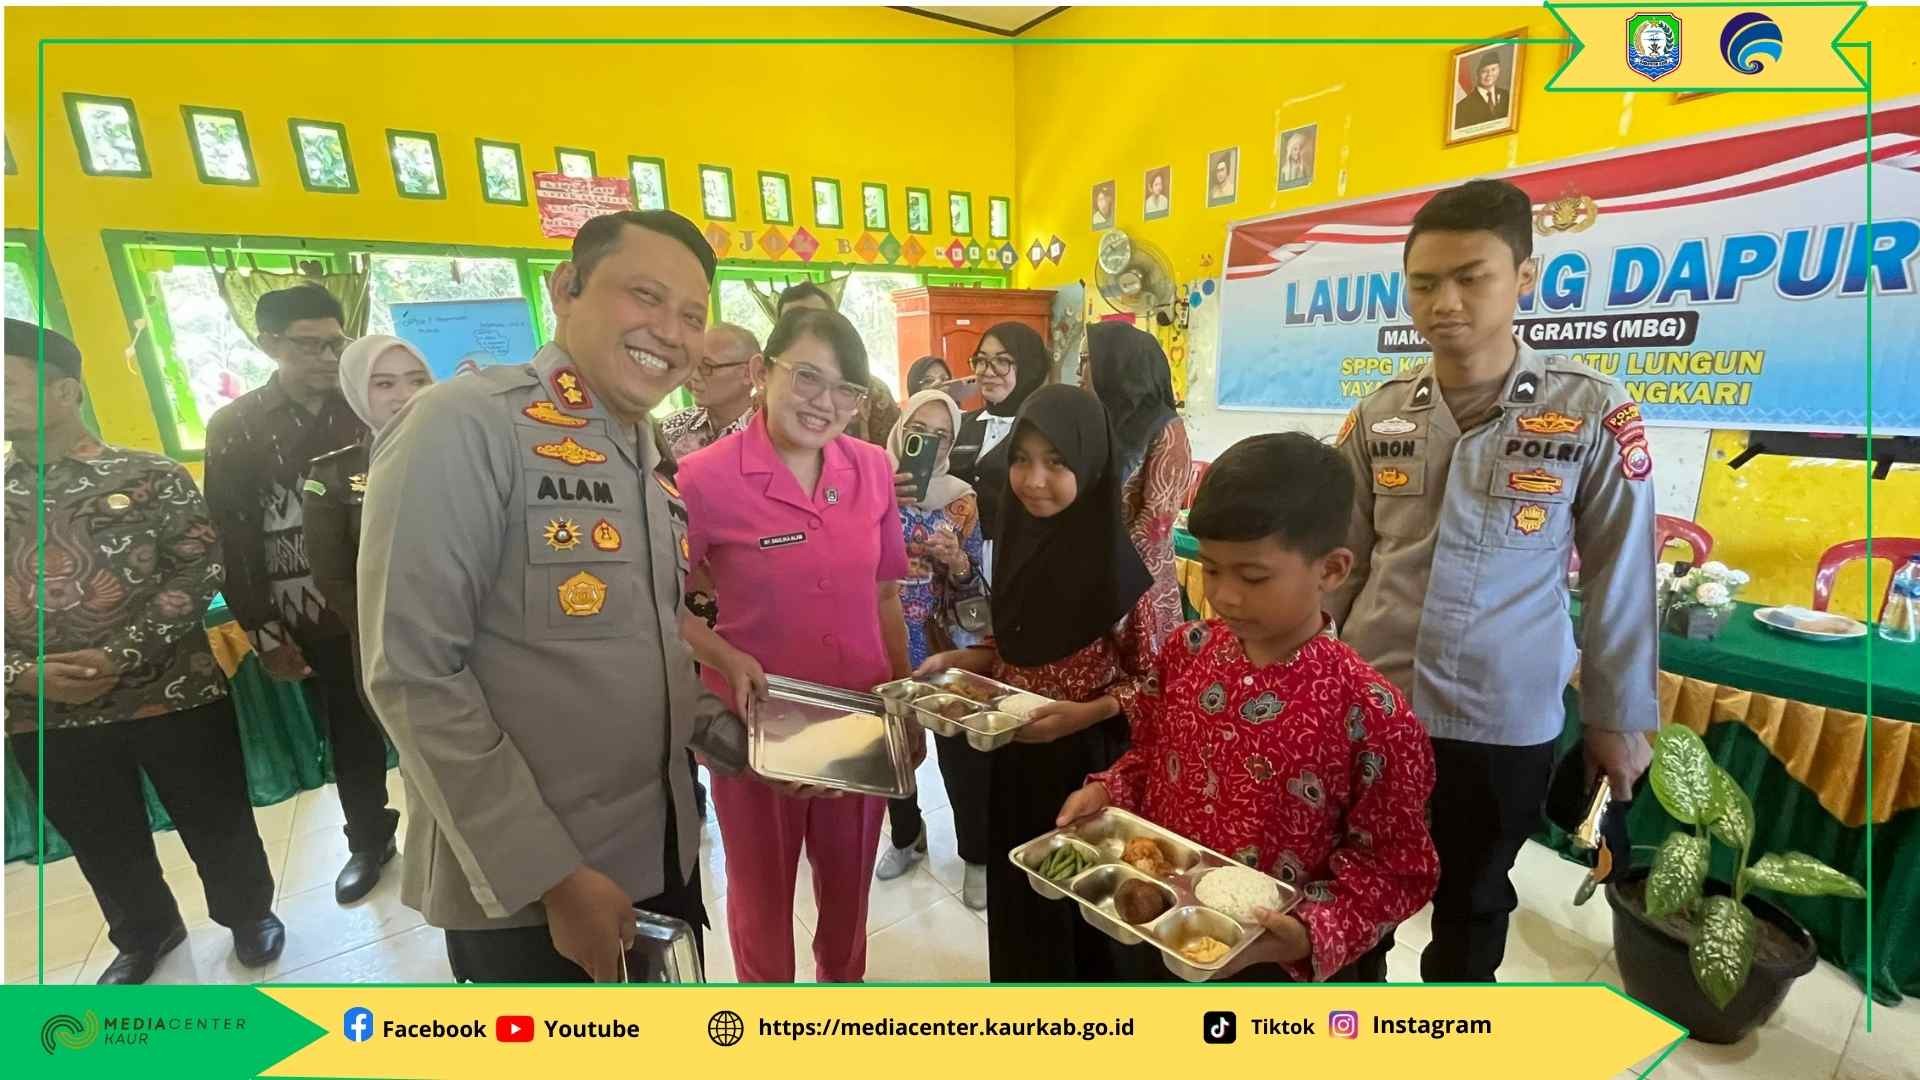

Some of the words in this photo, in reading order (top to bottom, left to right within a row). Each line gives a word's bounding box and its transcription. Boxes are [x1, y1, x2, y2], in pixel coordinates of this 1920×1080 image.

[1605, 218, 1920, 308] DAPUR
[1530, 321, 1607, 341] GRATIS
[1613, 317, 1685, 342] (MBG)
[1341, 357, 1392, 376] SPPG
[1626, 351, 1764, 375] LUNGUN
[1505, 440, 1585, 462] POLRI
[537, 475, 614, 504] ALAM
